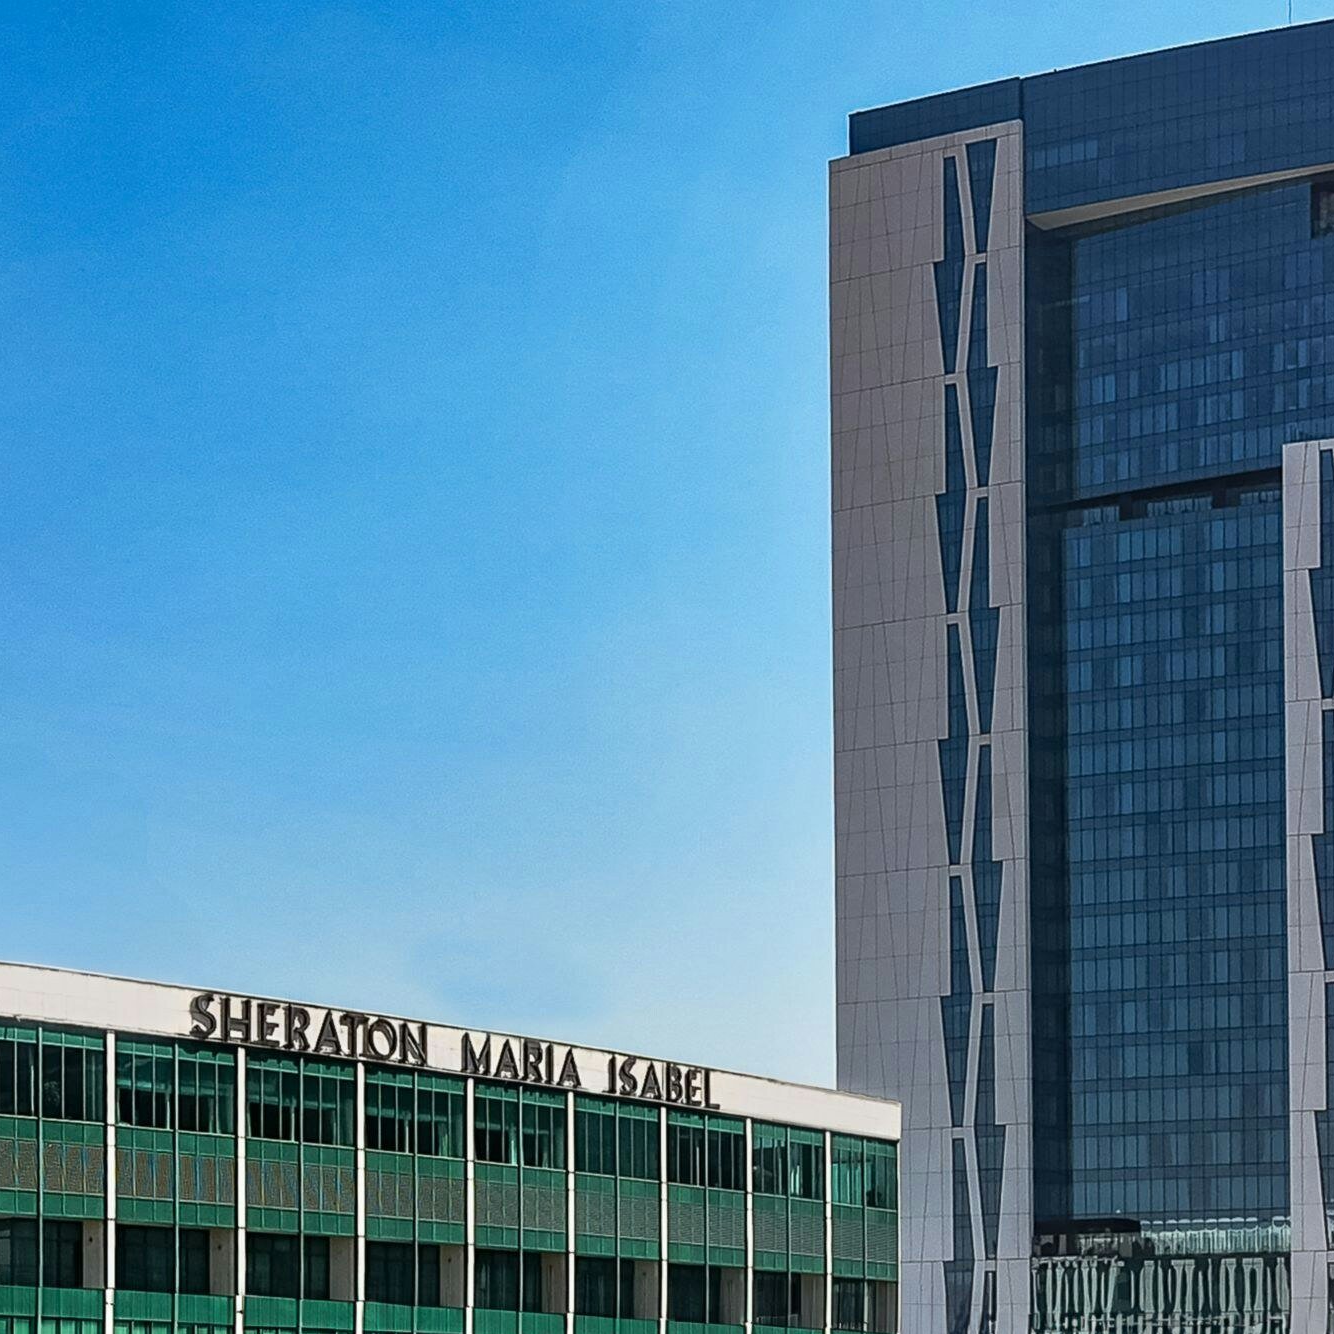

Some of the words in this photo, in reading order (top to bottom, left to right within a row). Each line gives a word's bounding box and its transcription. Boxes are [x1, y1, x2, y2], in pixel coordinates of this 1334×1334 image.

[189, 993, 428, 1066] SHERATON
[461, 1032, 581, 1088] MARIA
[602, 1053, 720, 1110] ISABEL
